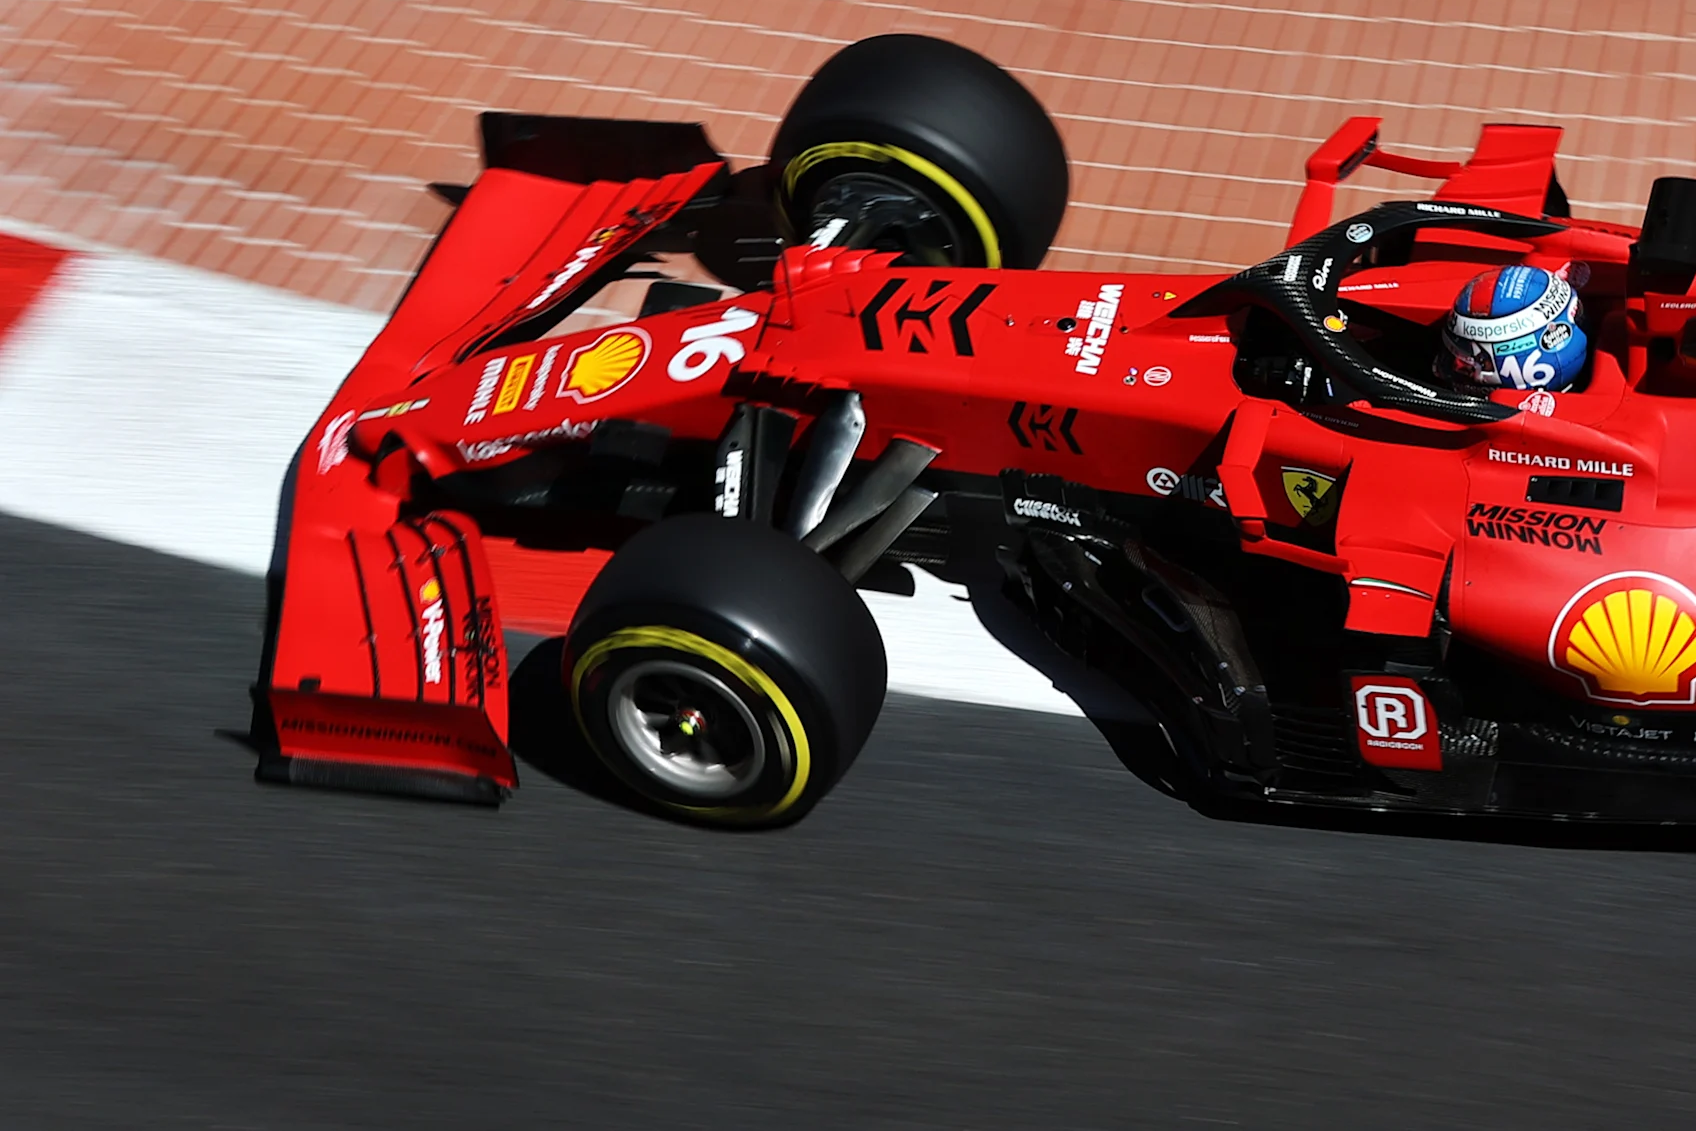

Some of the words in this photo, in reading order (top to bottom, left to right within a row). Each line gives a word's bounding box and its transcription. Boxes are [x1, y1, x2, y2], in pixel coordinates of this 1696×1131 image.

[1417, 202, 1466, 215] RICHARD
[1468, 208, 1501, 218] MILLE
[1312, 258, 1333, 291] Riva
[1533, 274, 1560, 312] MISSIO
[1543, 281, 1568, 320] WINNO
[1075, 284, 1125, 375] WEICHAI
[1463, 314, 1536, 339] kaspersky
[667, 306, 759, 382] 16
[1496, 340, 1535, 354] Riva
[1372, 367, 1437, 398] #WeRaceAsOne
[1500, 349, 1555, 390] 16
[464, 356, 507, 426] MAHLE
[1488, 449, 1571, 470] RICHARD
[1577, 459, 1634, 477] MILLE
[1467, 503, 1607, 535] MISSION
[1466, 519, 1603, 555] WINNOW
